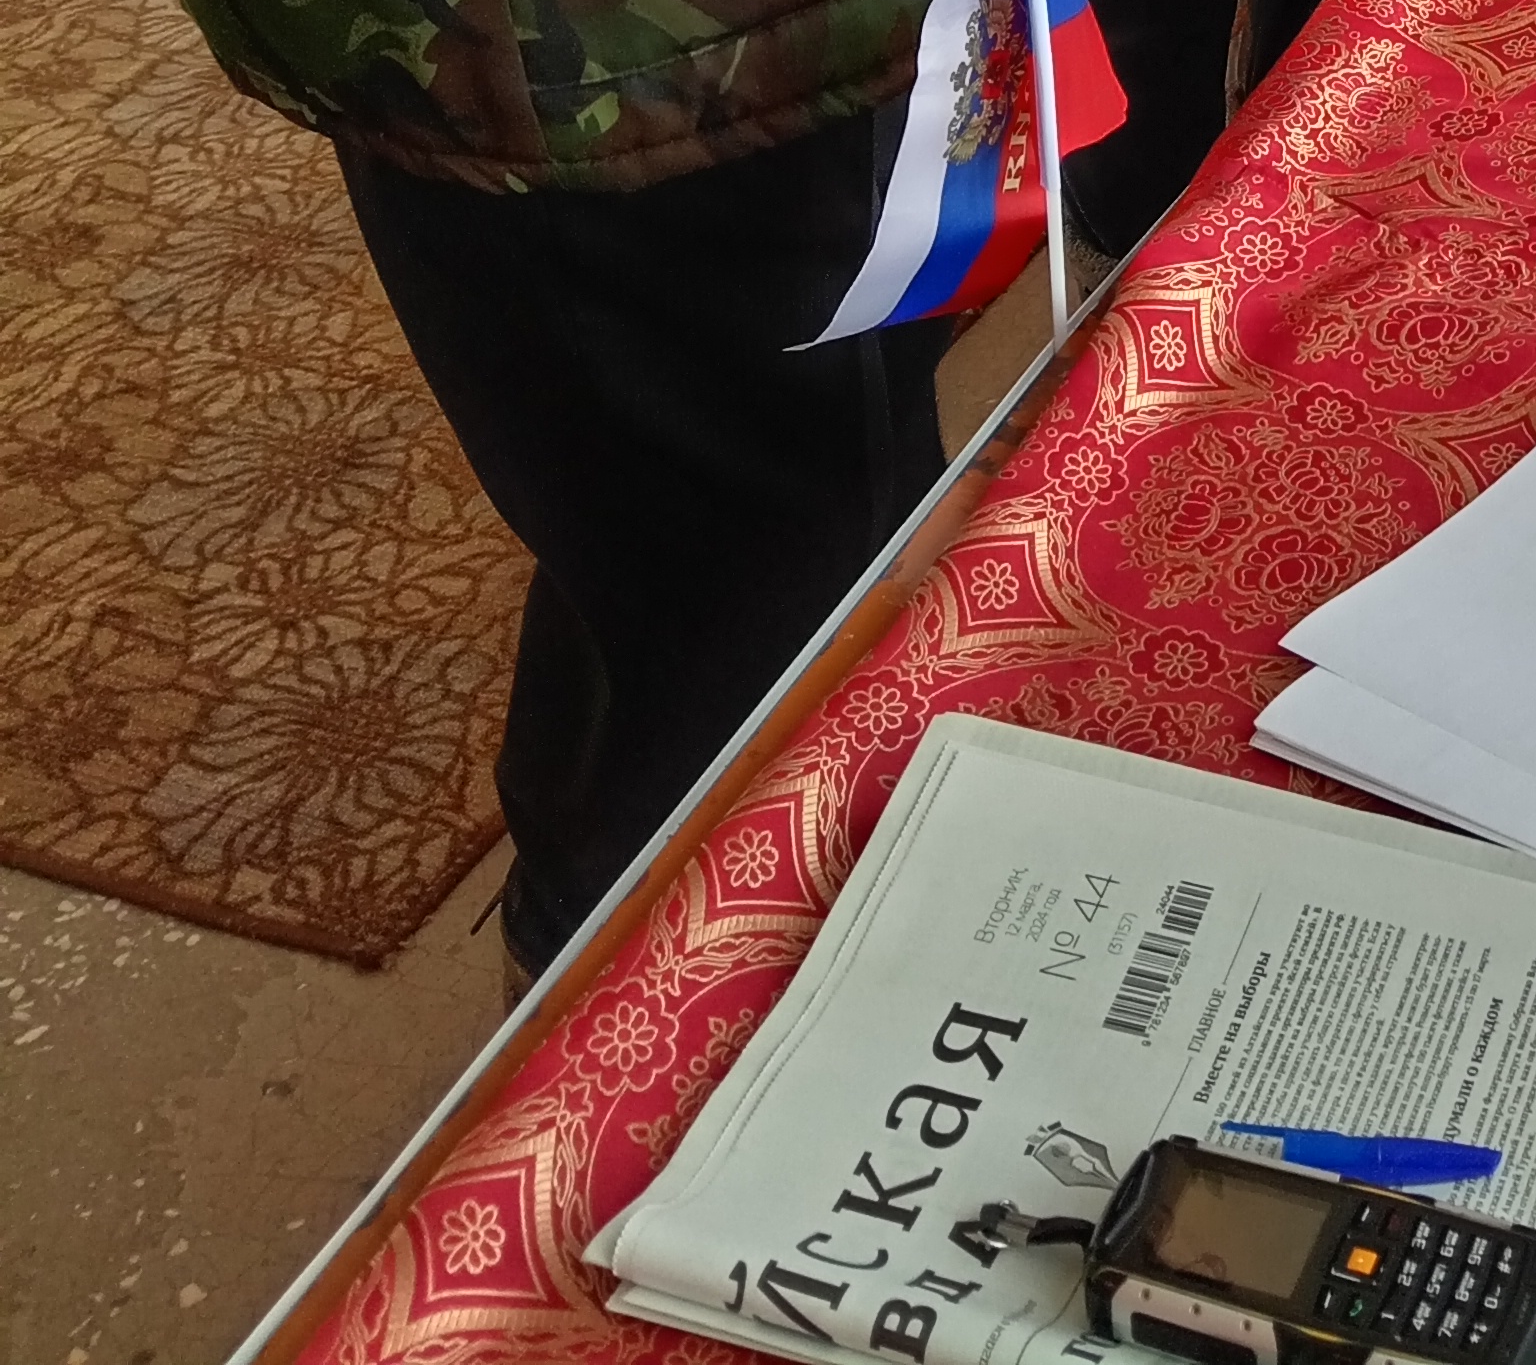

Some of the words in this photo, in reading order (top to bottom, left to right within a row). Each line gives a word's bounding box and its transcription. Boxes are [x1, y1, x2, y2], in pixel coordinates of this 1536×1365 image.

[974, 868, 1029, 944] Вторник,
[1005, 923, 1022, 936] 12
[1015, 883, 1043, 922] марта,
[1026, 912, 1049, 942] 2024
[1043, 889, 1062, 910] год
[1074, 874, 1120, 923] 44
[1156, 885, 1175, 915] 24044
[1107, 913, 1138, 955] (31157)
[1148, 996, 1172, 1030] 781234
[1187, 988, 1226, 1053] ГЛАВНОЕ
[1193, 1045, 1231, 1103] Вместе
[1224, 1022, 1241, 1042] на
[1234, 952, 1271, 1019] выборы
[1297, 988, 1317, 1026] выборы
[1471, 997, 1503, 1063] каждом
[1467, 1066, 1478, 1076] о
[1204, 1120, 1218, 1143] олее
[1214, 1102, 1227, 1117] 100
[1443, 1079, 1474, 1144] думали
[1398, 1273, 1413, 1287] 2
[1411, 1237, 1427, 1250] 3
[1412, 1317, 1426, 1331] 4
[1426, 1281, 1441, 1295] 5
[1440, 1245, 1455, 1258] 6
[1437, 1325, 1452, 1338] 7
[1455, 1288, 1470, 1302] 8
[1467, 1254, 1482, 1266] 9
[1484, 1296, 1498, 1310] 0
